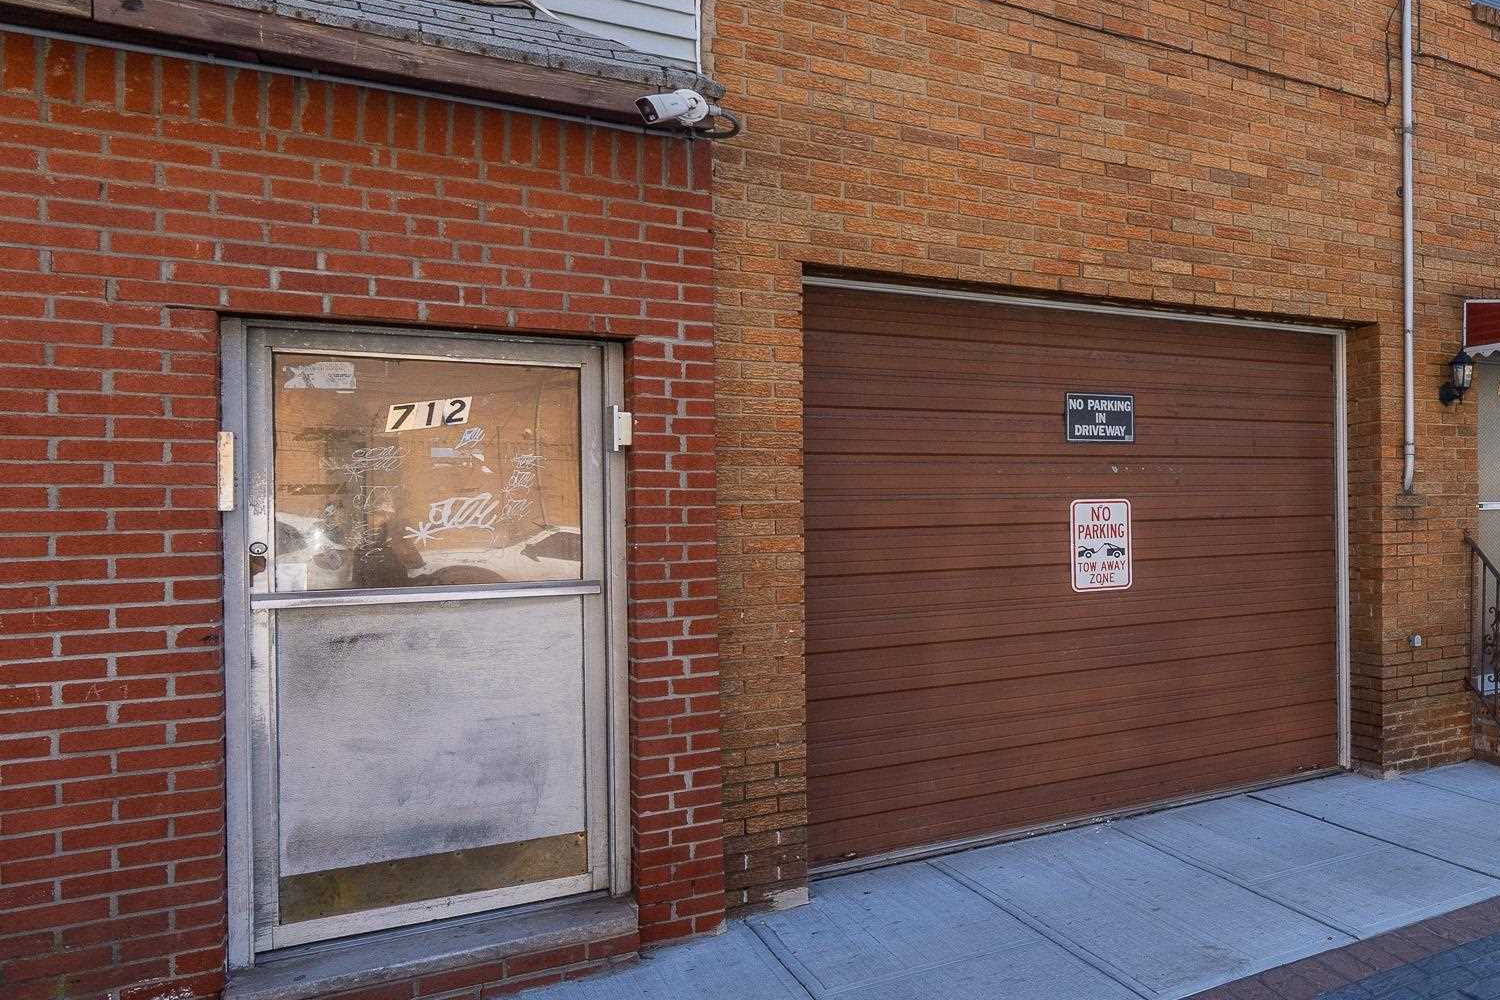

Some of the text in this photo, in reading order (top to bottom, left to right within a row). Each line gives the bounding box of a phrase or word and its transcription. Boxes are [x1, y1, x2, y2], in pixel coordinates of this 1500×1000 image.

[1069, 398, 1131, 412] NO PARKING
[391, 399, 466, 430] 712
[1095, 412, 1106, 424] IN
[1074, 424, 1127, 437] DRIVEWAY
[1091, 506, 1111, 521] NO
[1078, 523, 1125, 540] PARKING
[1078, 560, 1126, 573] TOW AWAY
[1089, 572, 1115, 584] ZONE
